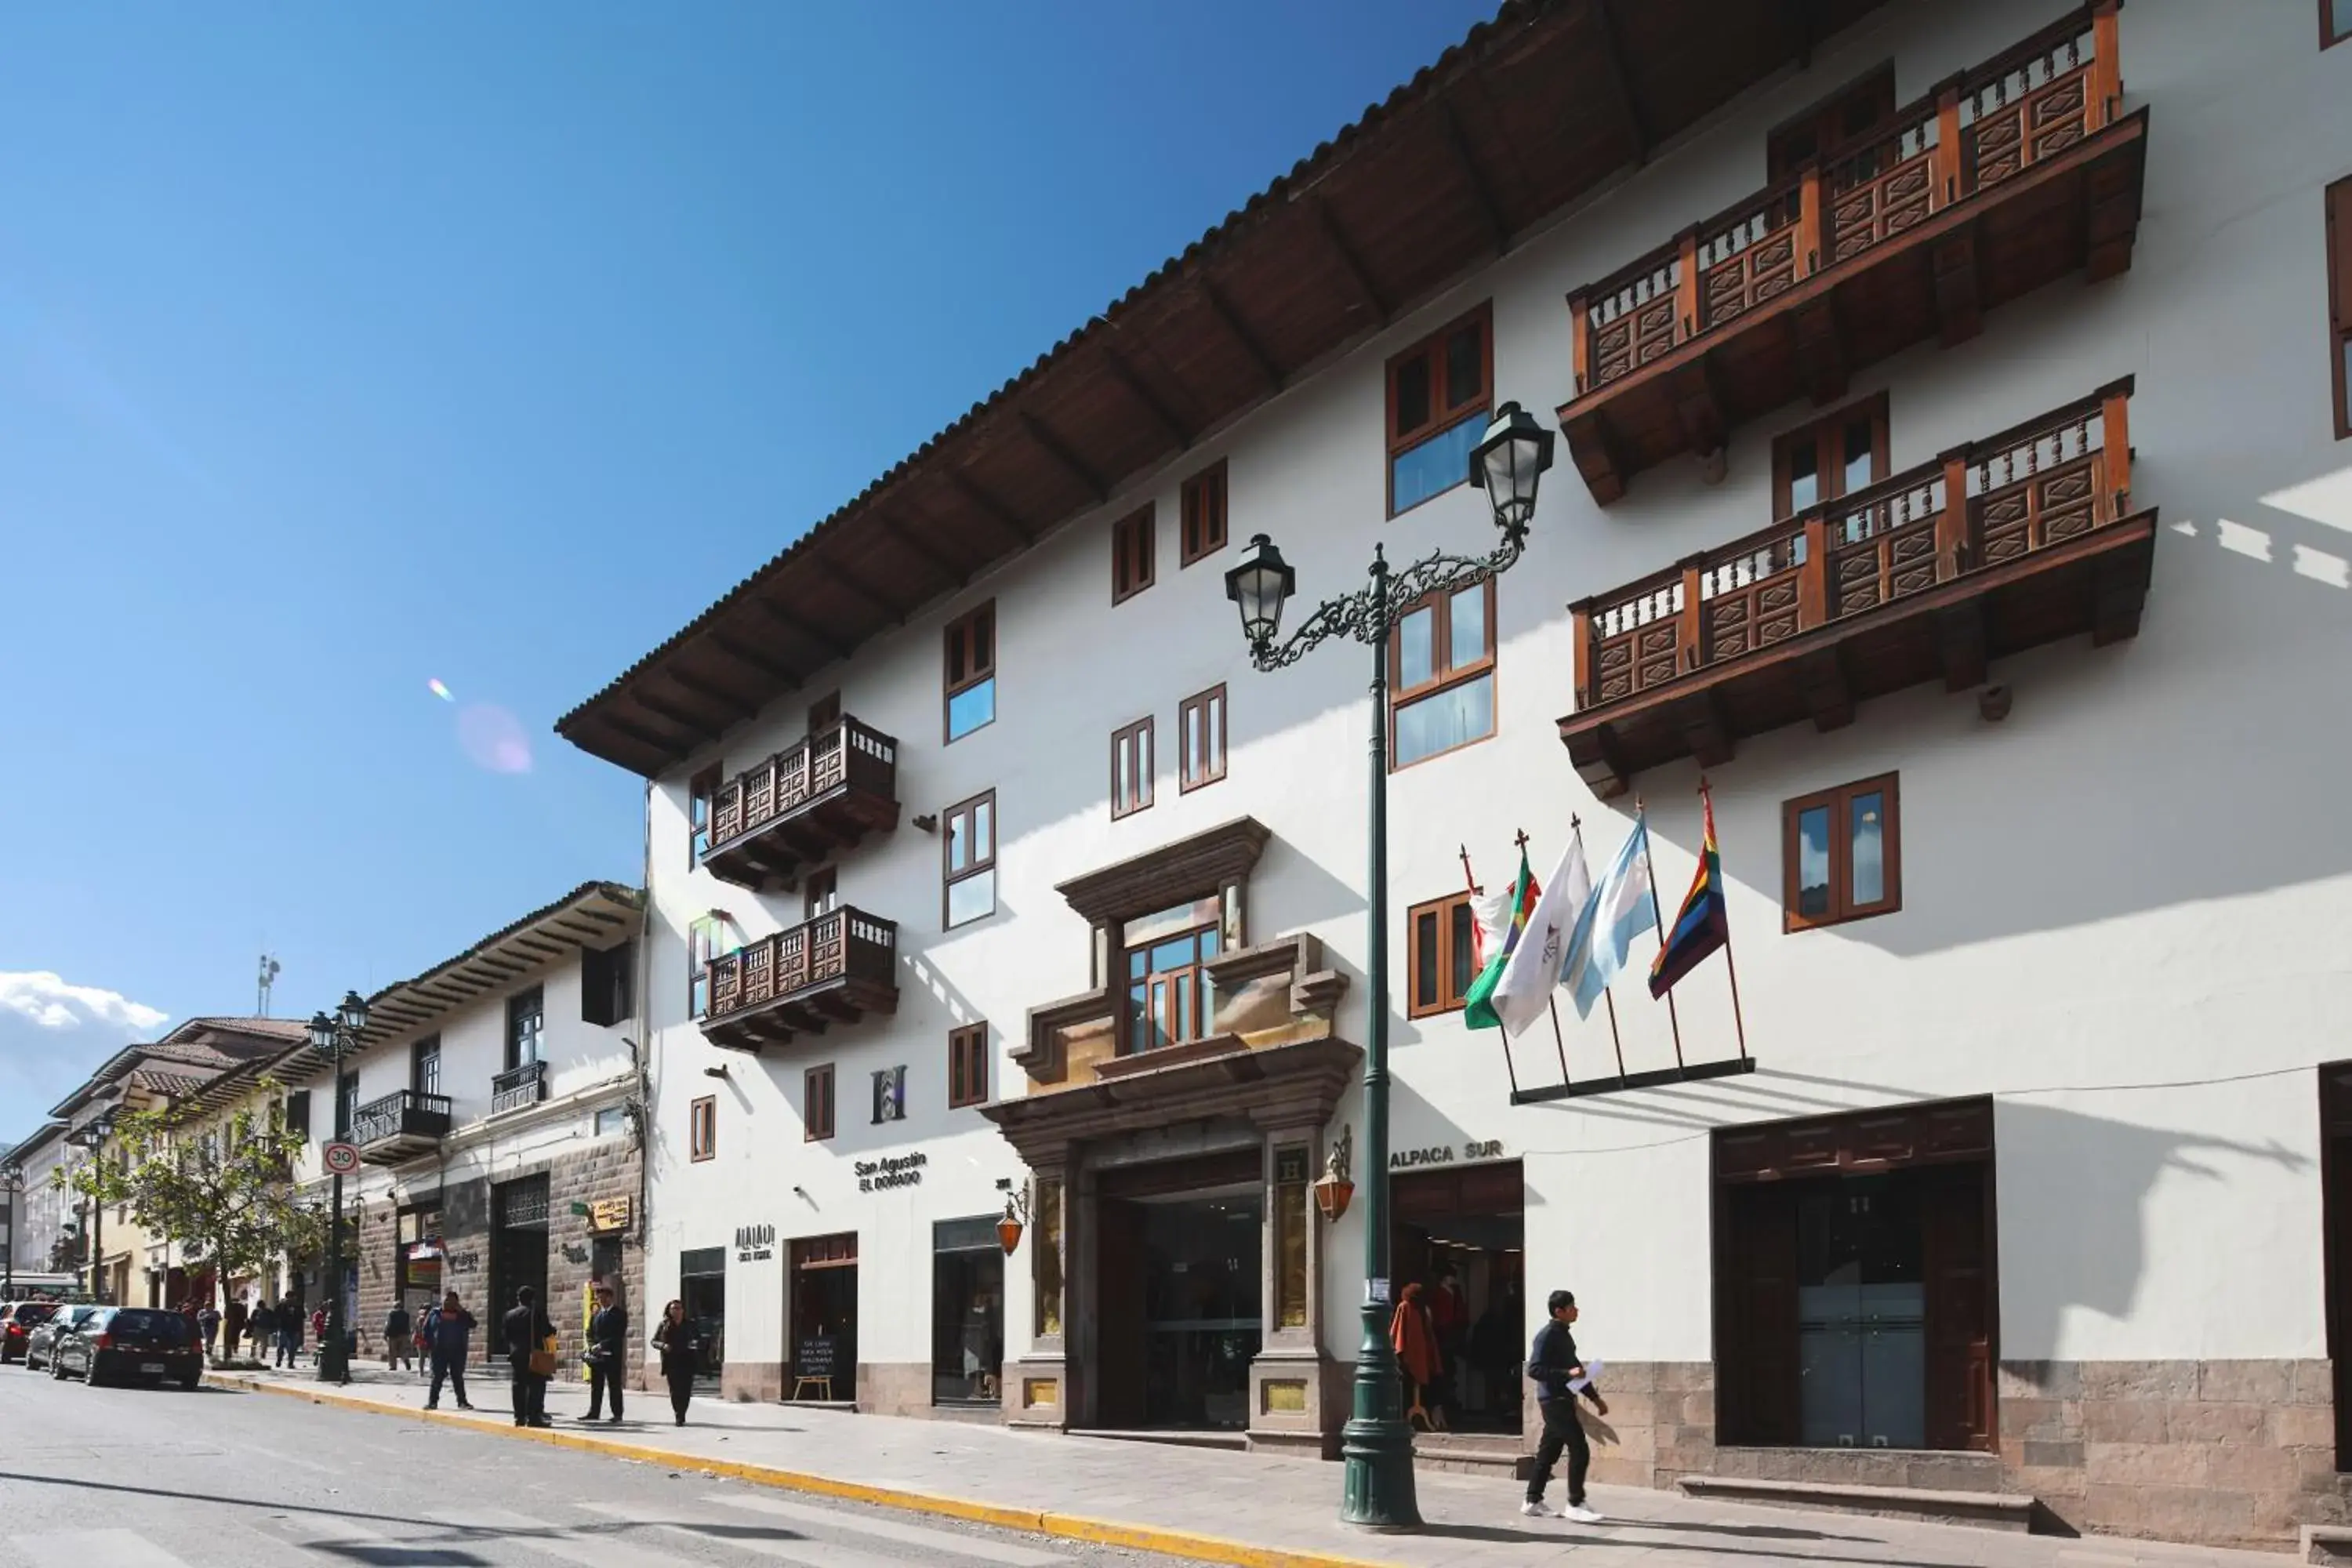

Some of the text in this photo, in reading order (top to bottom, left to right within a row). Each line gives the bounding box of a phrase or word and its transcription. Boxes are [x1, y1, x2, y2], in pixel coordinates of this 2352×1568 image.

[332, 1150, 351, 1163] 30
[1390, 1139, 1504, 1168] ALPACA SUR
[854, 1161, 877, 1177] San
[858, 1171, 921, 1192] EL DORADO
